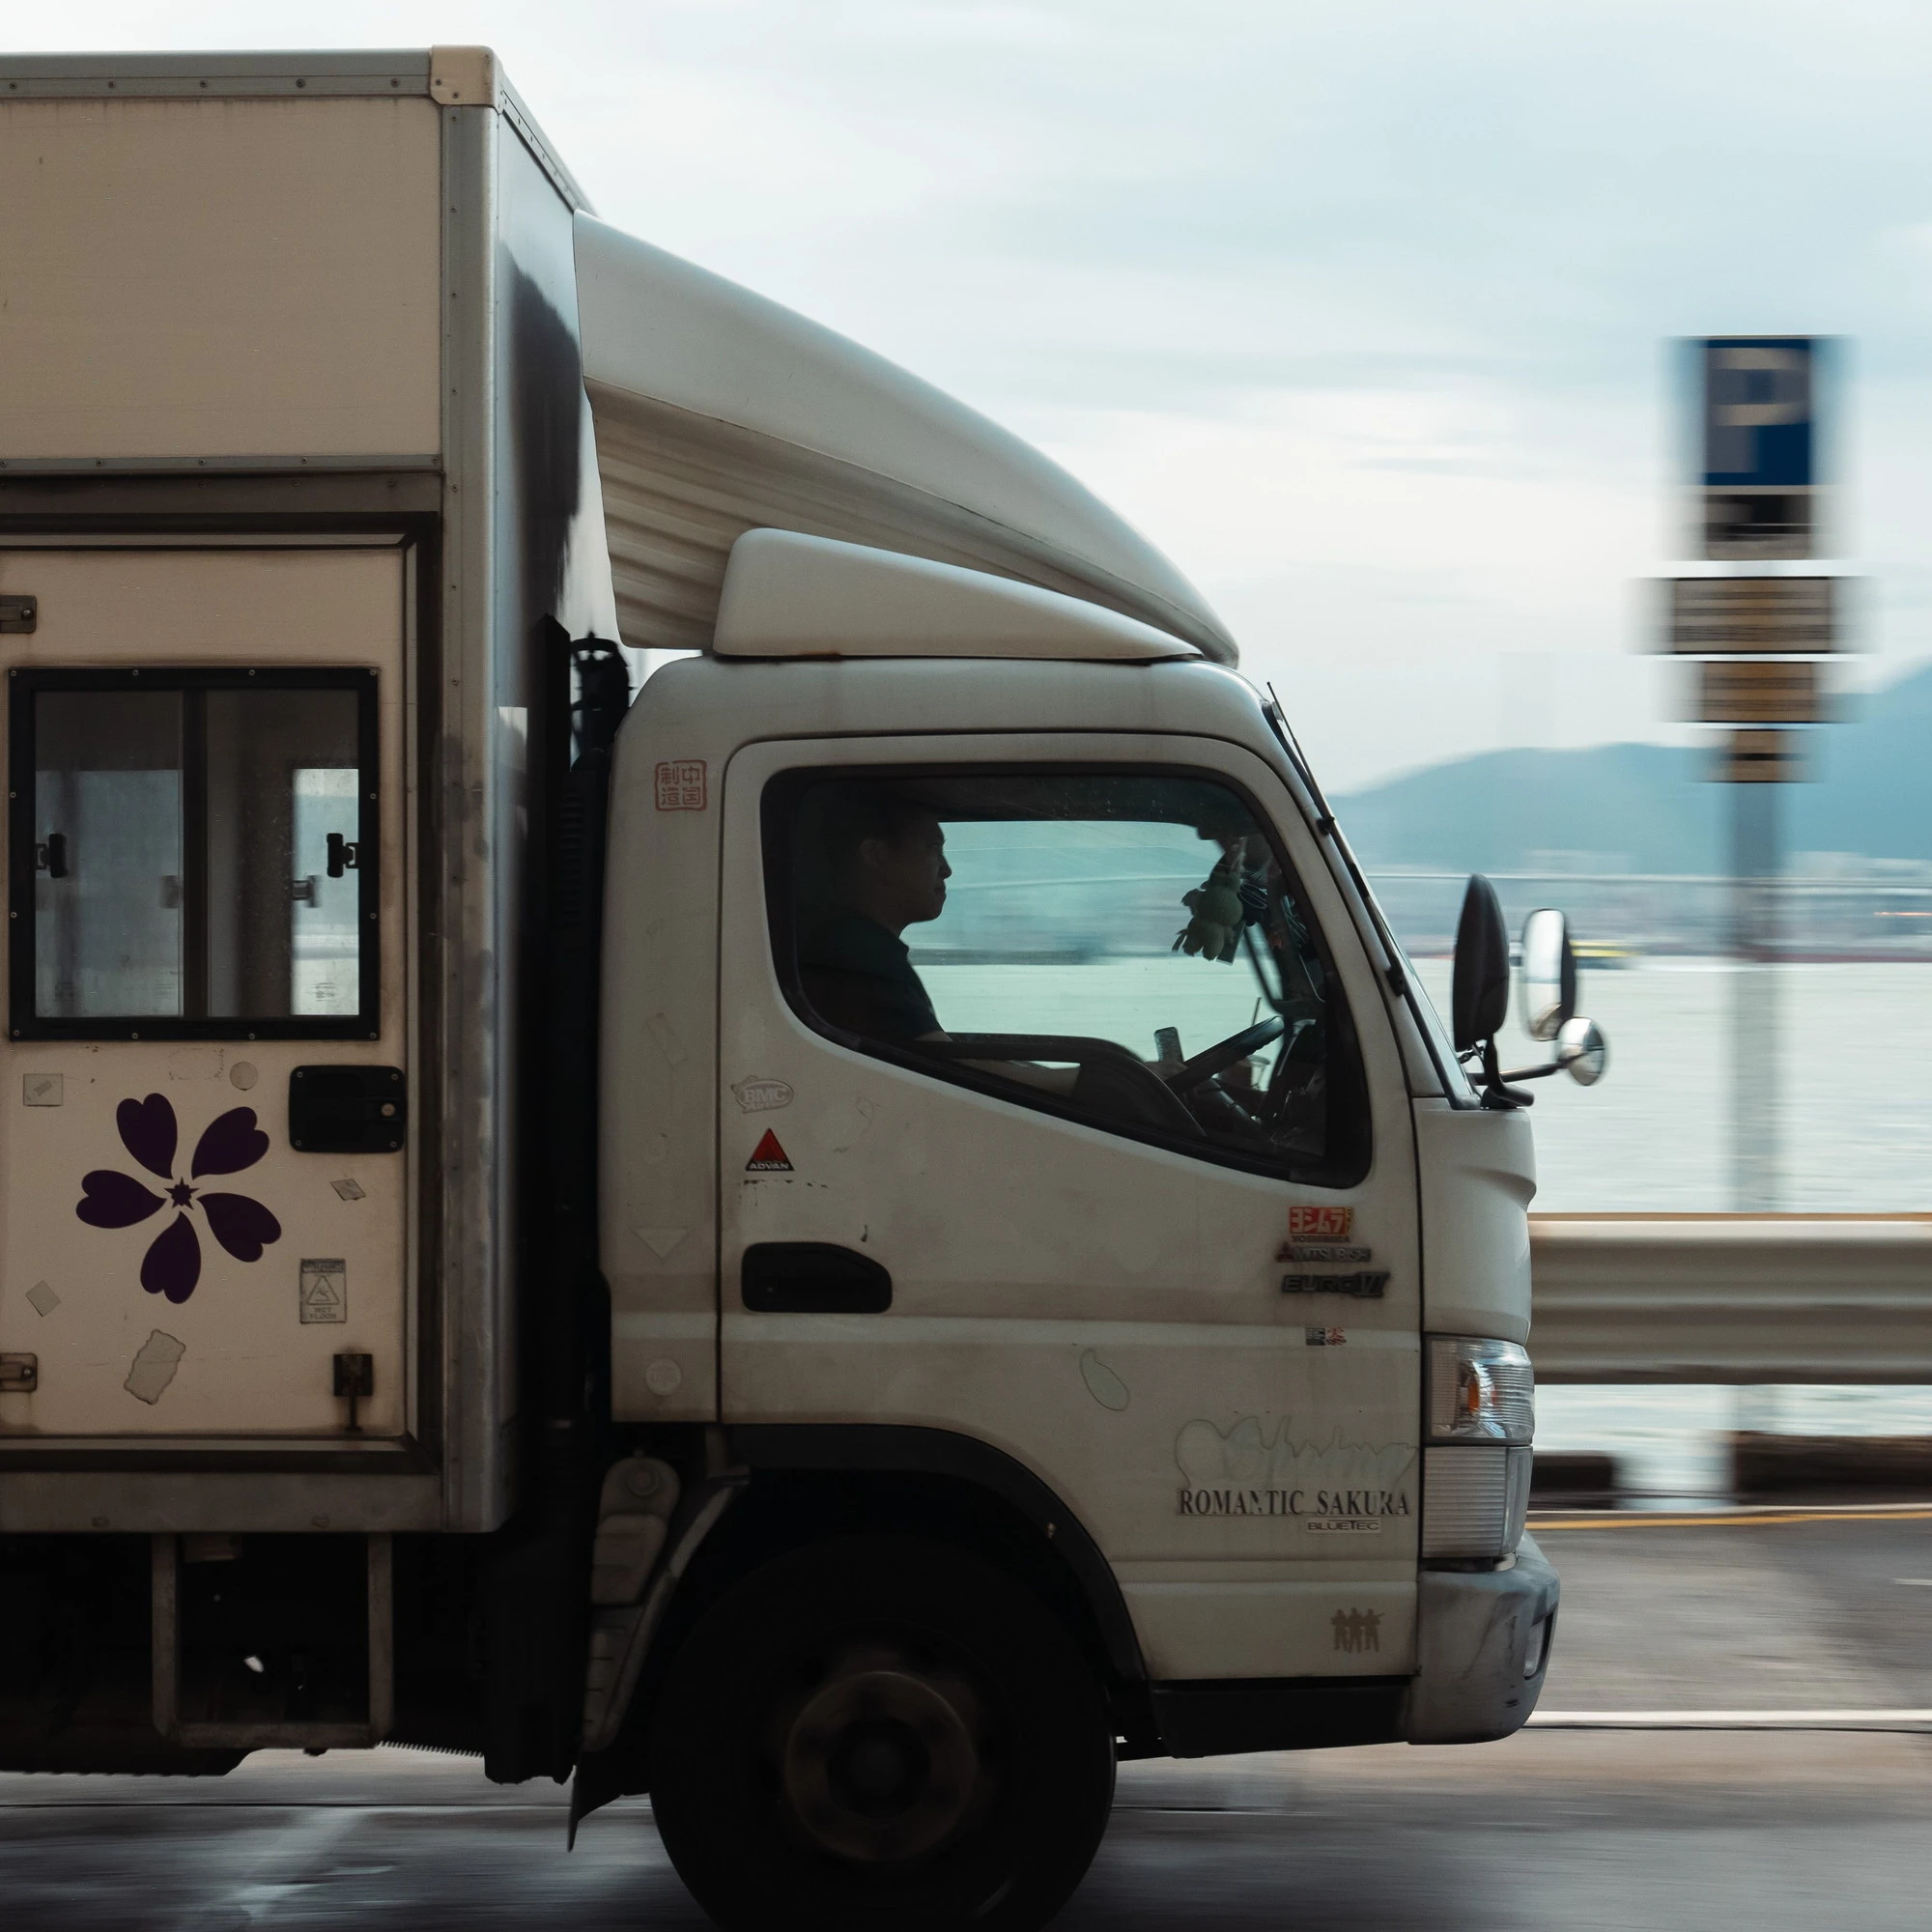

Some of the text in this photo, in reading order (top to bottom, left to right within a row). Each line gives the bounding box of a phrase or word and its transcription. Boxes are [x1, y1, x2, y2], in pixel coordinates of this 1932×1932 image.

[1290, 1207, 1346, 1234] ヨシムラ
[1293, 1247, 1371, 1262] MITSBS
[1179, 1490, 1409, 1515] ROMANTIC SAKURA
